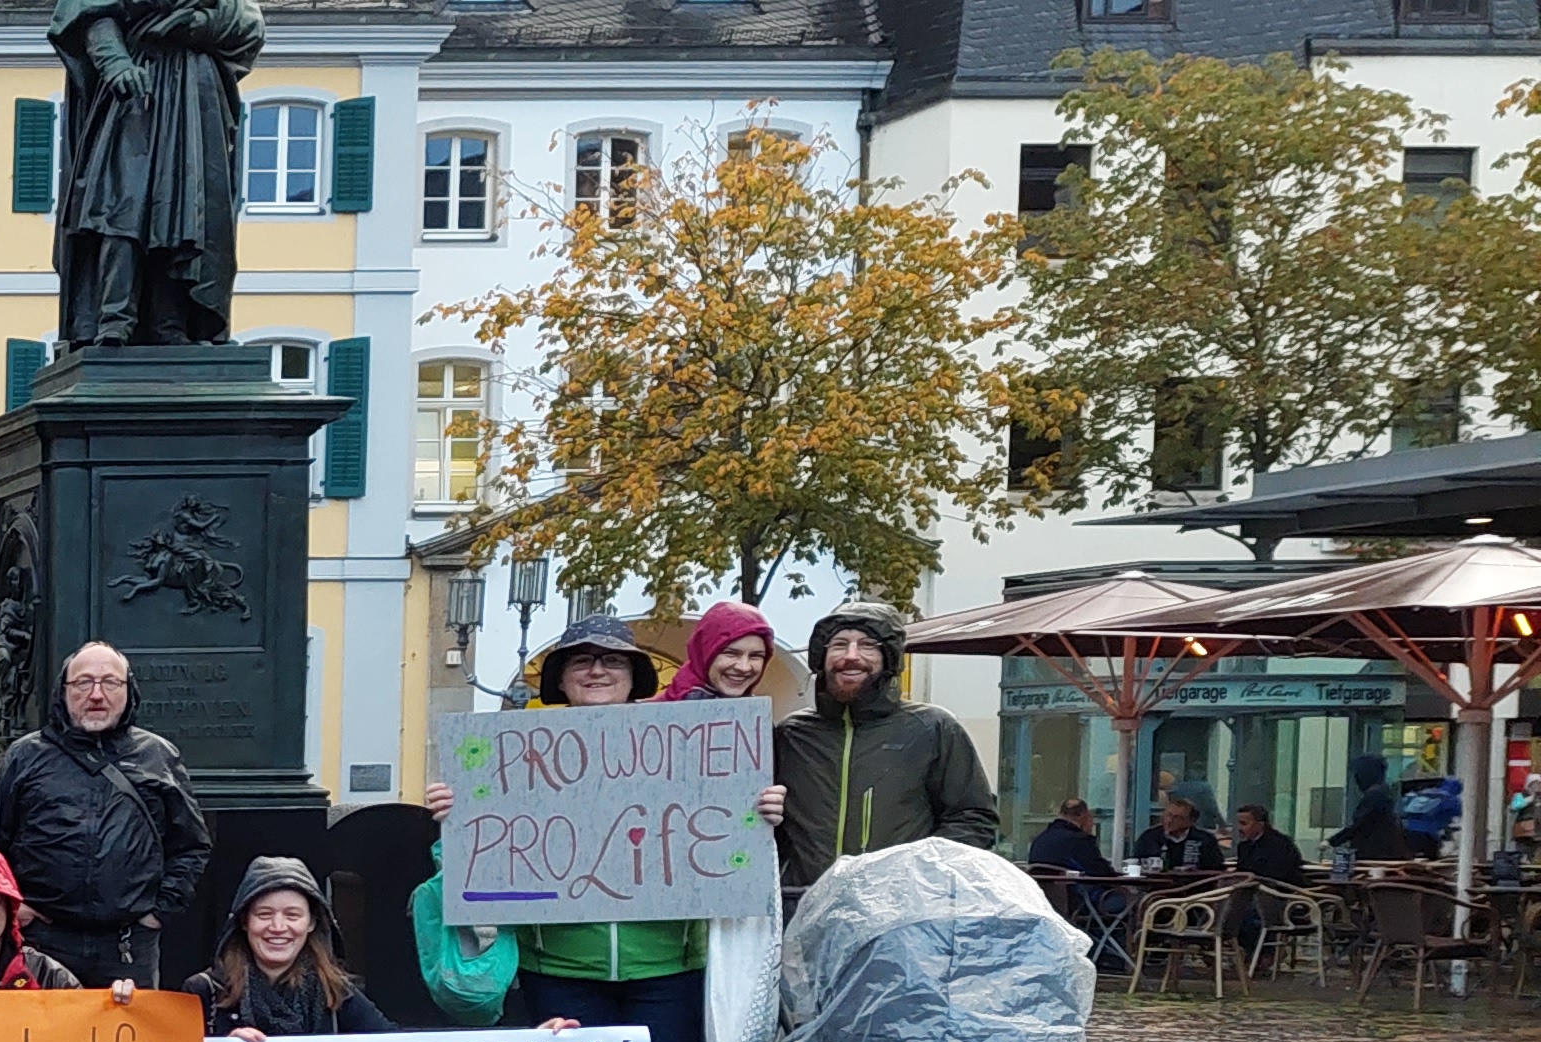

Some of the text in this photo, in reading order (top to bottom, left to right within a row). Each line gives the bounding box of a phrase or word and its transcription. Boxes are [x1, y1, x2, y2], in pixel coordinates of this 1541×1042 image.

[1316, 683, 1392, 704] Tiefgarage
[492, 716, 762, 795] PRO WOMEN
[464, 813, 577, 888] PRO
